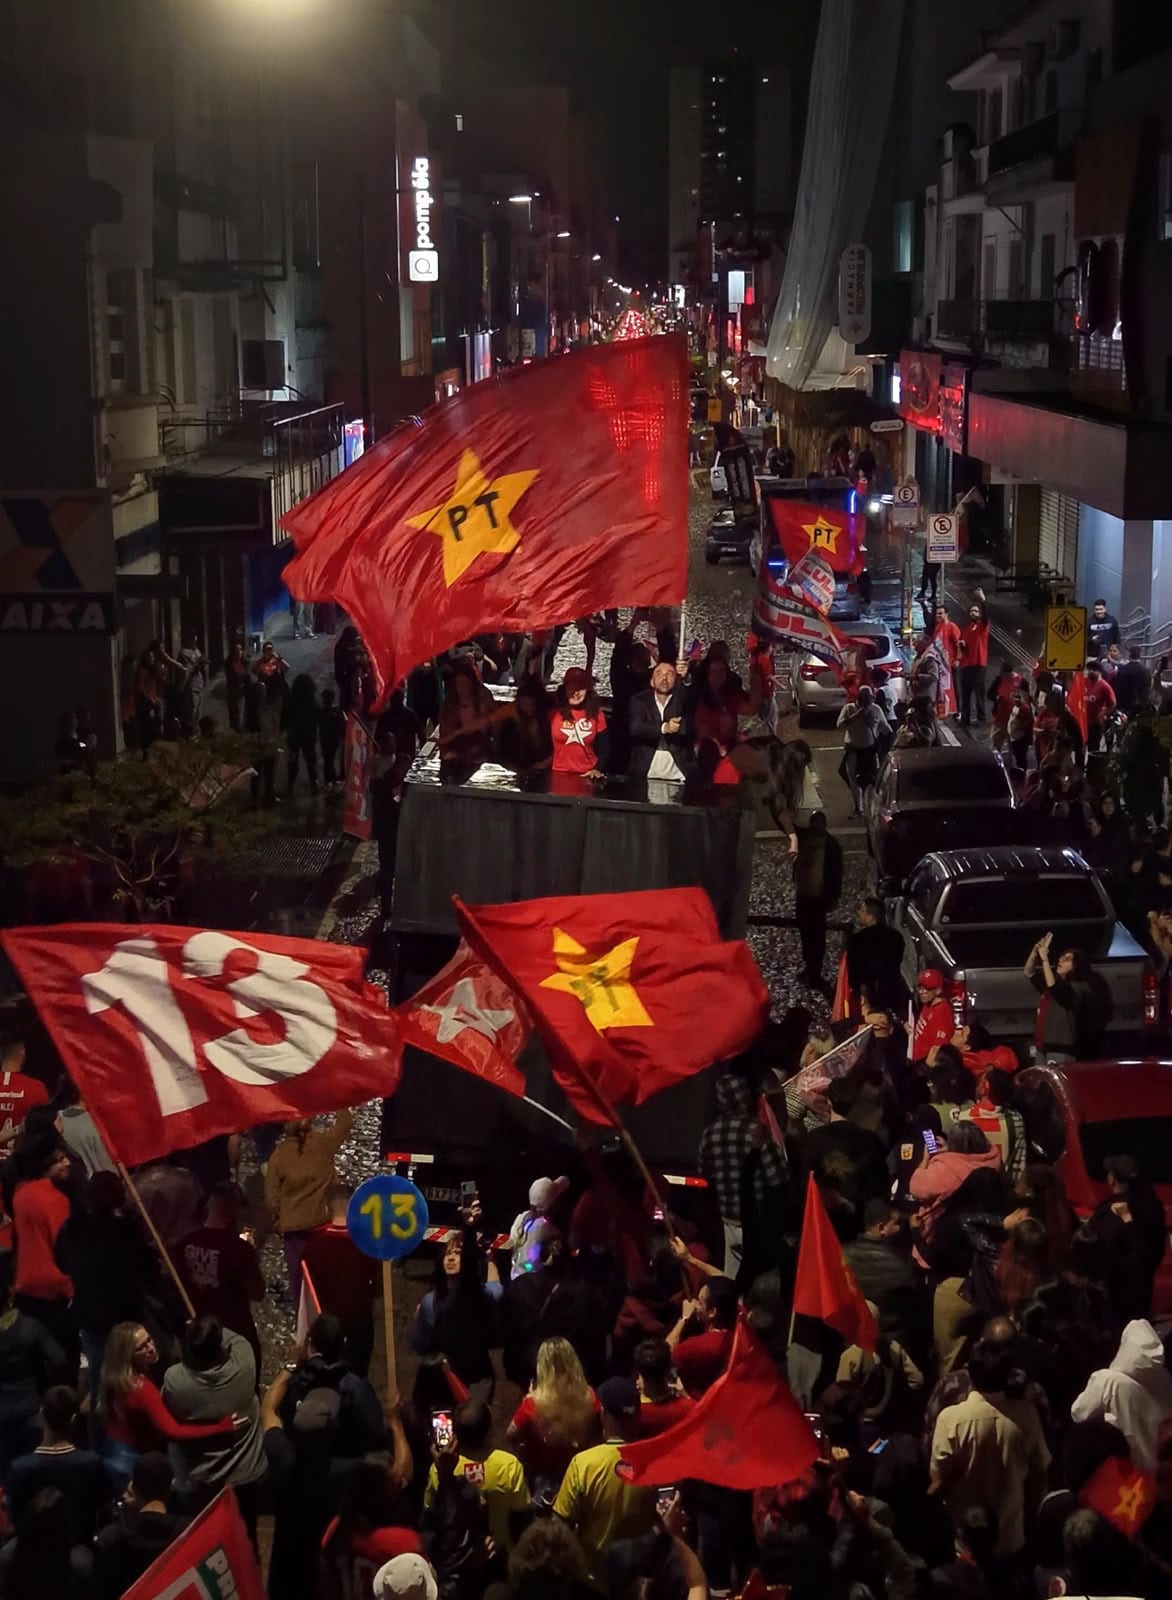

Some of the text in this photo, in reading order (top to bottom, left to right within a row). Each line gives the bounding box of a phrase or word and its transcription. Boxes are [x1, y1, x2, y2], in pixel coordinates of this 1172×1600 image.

[411, 157, 434, 248] pompéia
[447, 491, 499, 542] PT
[813, 528, 833, 545] PT
[80, 931, 338, 1116] 13
[360, 1193, 418, 1239] 13
